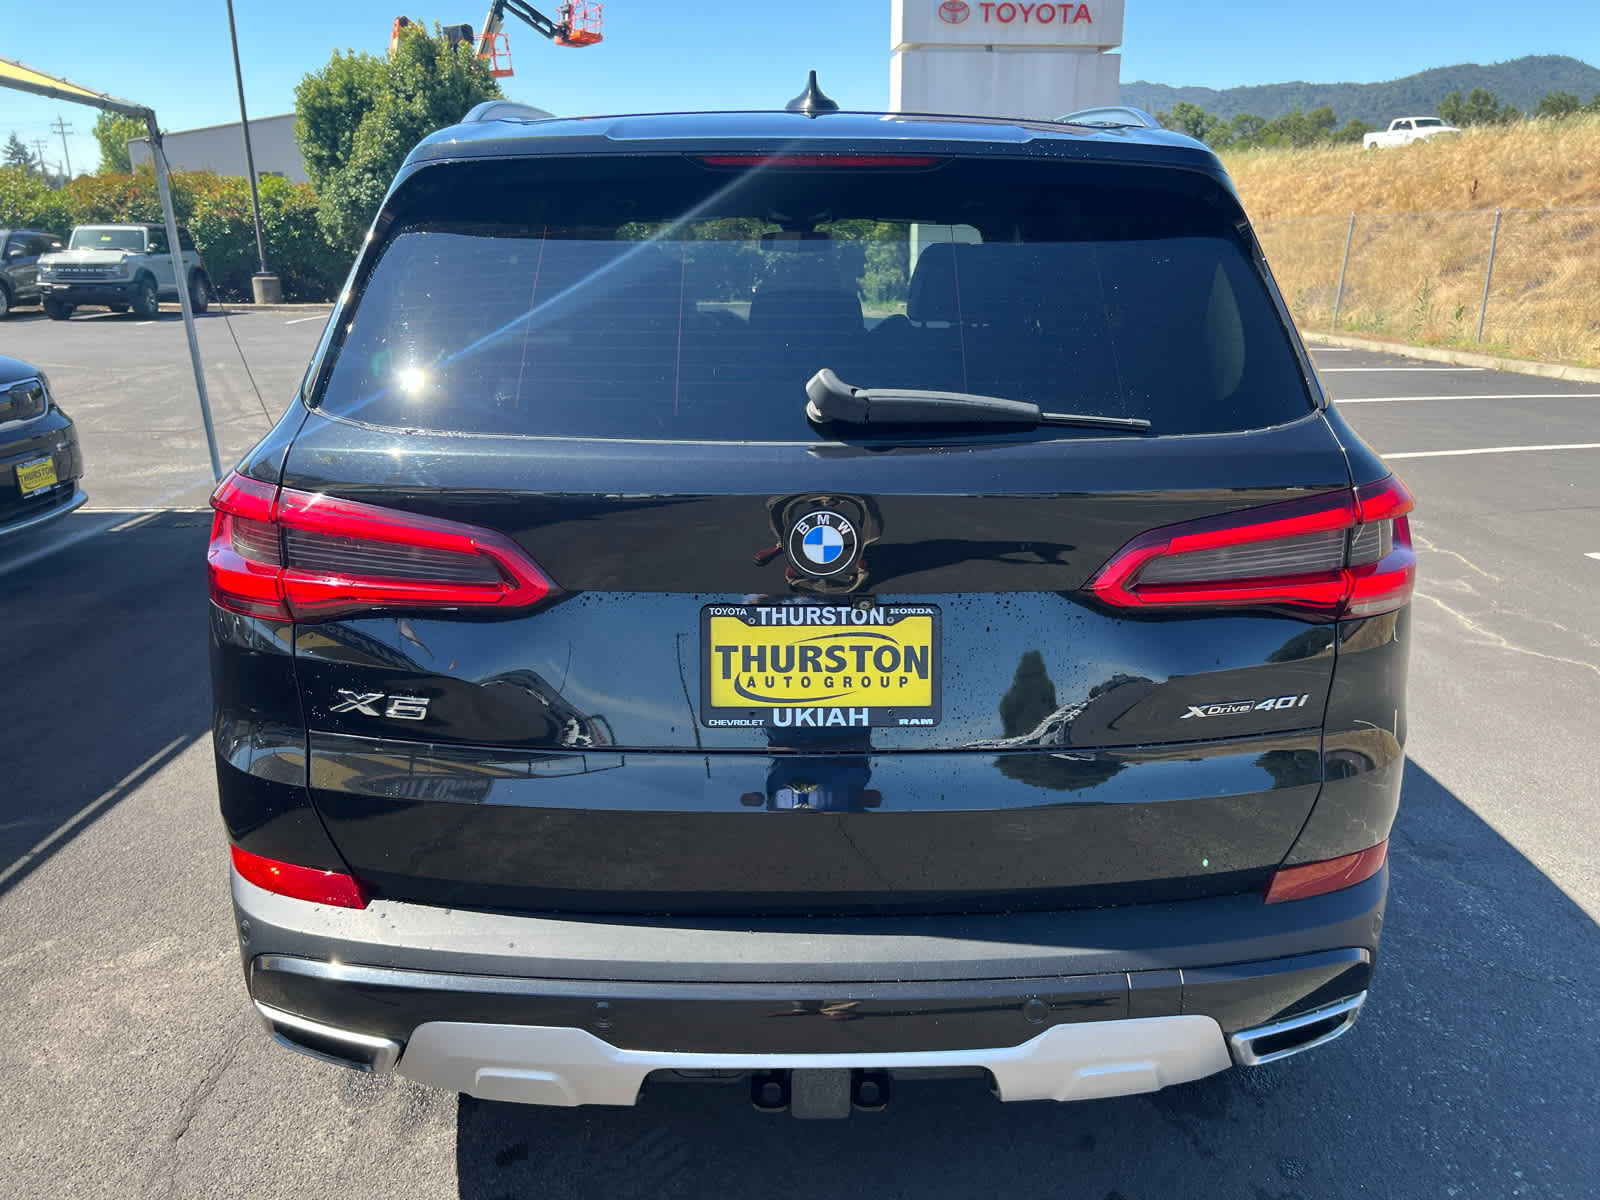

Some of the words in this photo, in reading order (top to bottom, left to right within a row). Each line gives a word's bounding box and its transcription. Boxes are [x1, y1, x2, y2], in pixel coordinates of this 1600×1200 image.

[980, 3, 1092, 24] TOYOTA
[797, 514, 851, 535] BMW
[709, 607, 747, 616] TOYOTA
[757, 607, 884, 625] THURSTON
[714, 645, 929, 679] THURSTON
[746, 676, 811, 688] AUTO
[824, 676, 909, 688] GROUP
[330, 688, 430, 720] X5
[773, 708, 869, 726] UKIAH
